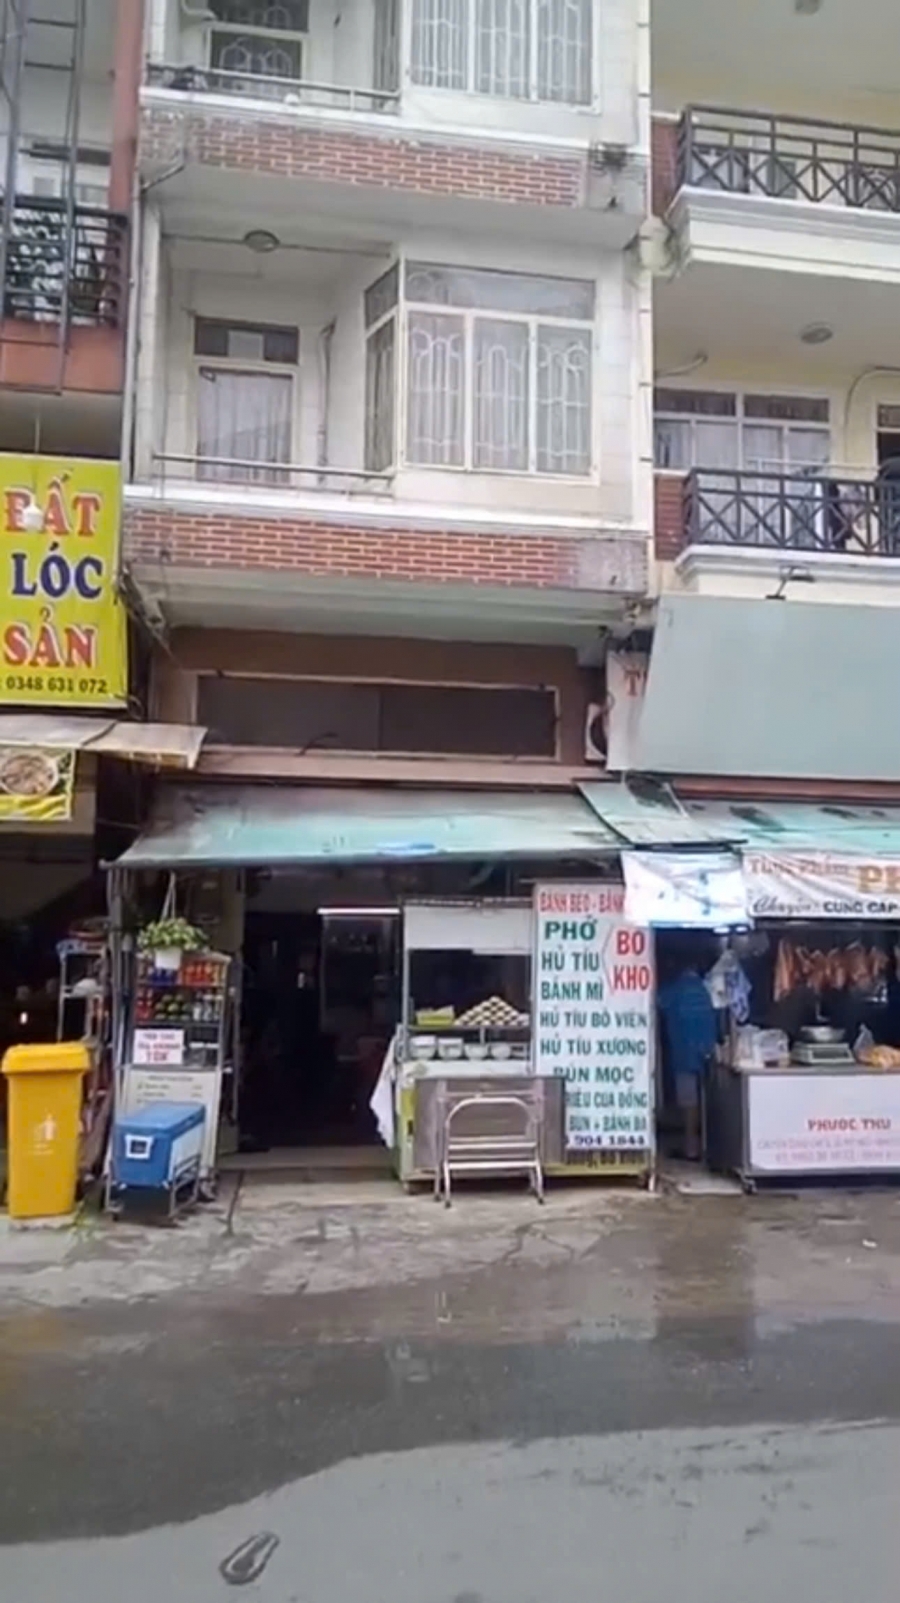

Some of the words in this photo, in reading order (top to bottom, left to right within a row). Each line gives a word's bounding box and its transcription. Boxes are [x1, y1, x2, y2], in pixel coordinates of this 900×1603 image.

[11, 541, 103, 598] LÓC
[4, 605, 96, 668] SẢN
[6, 676, 43, 691] 0348
[47, 677, 74, 692] 631
[79, 678, 107, 694] 072
[823, 901, 863, 914] CUNG
[544, 915, 598, 941] PHỞ
[541, 945, 565, 971] HỦ
[541, 975, 580, 1001] BÁNH
[612, 964, 651, 991] KHO
[540, 1005, 560, 1029] HỦ
[540, 1032, 562, 1056] HỦ
[595, 1066, 635, 1086] MỌC
[594, 1091, 615, 1109] CUA
